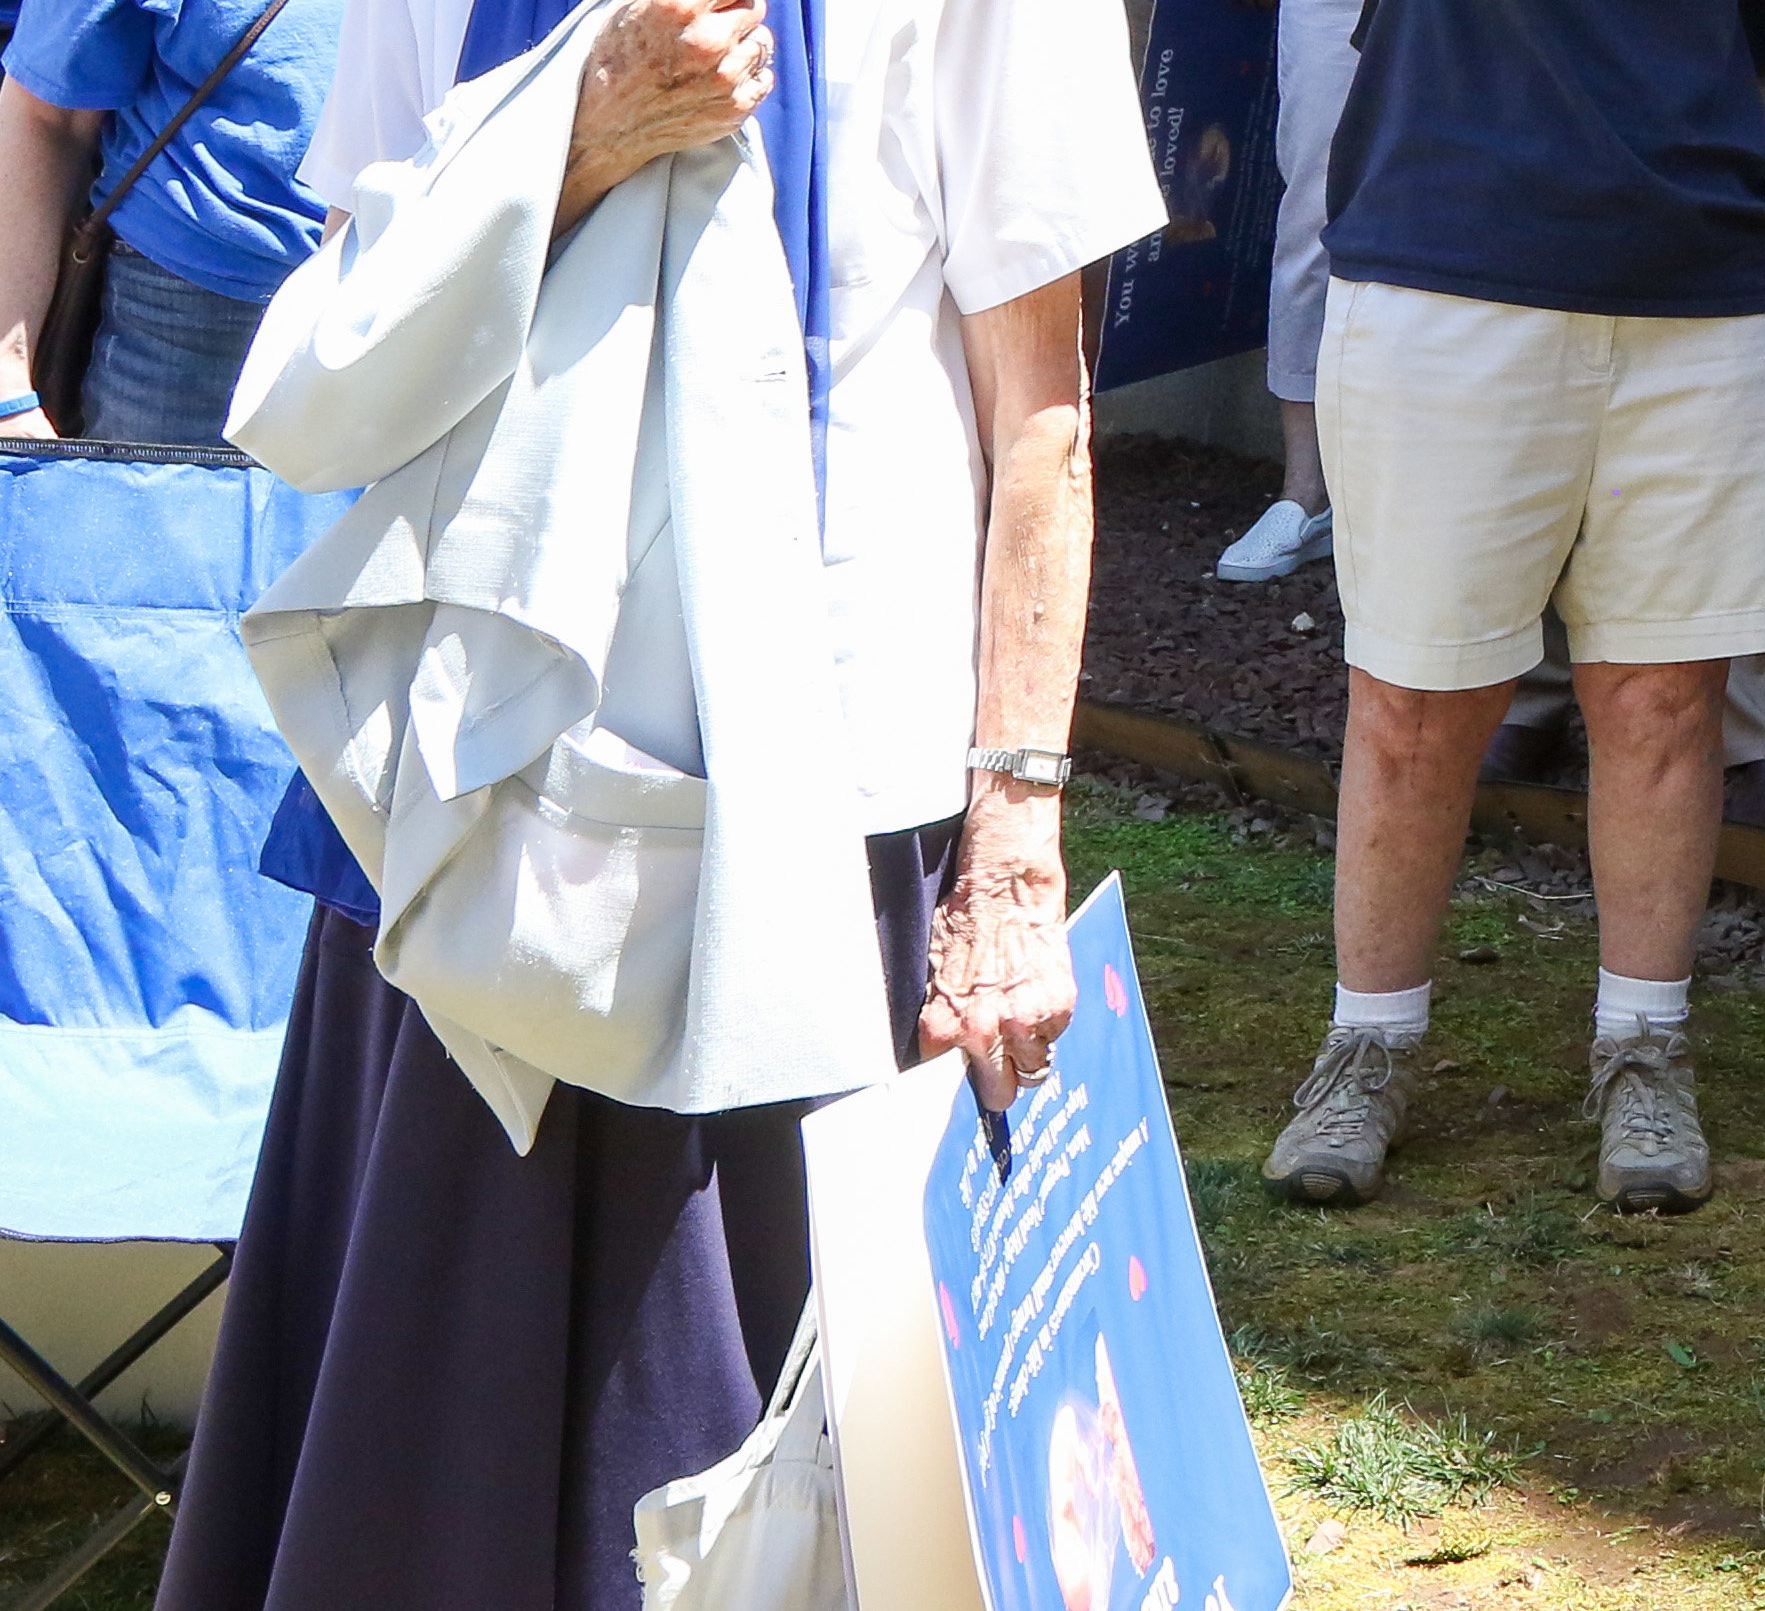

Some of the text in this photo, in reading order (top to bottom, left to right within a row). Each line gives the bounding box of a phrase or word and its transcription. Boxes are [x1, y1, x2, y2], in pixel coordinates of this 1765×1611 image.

[1151, 48, 1174, 98] love
[1161, 106, 1184, 177] loved!
[1115, 279, 1135, 329] You
